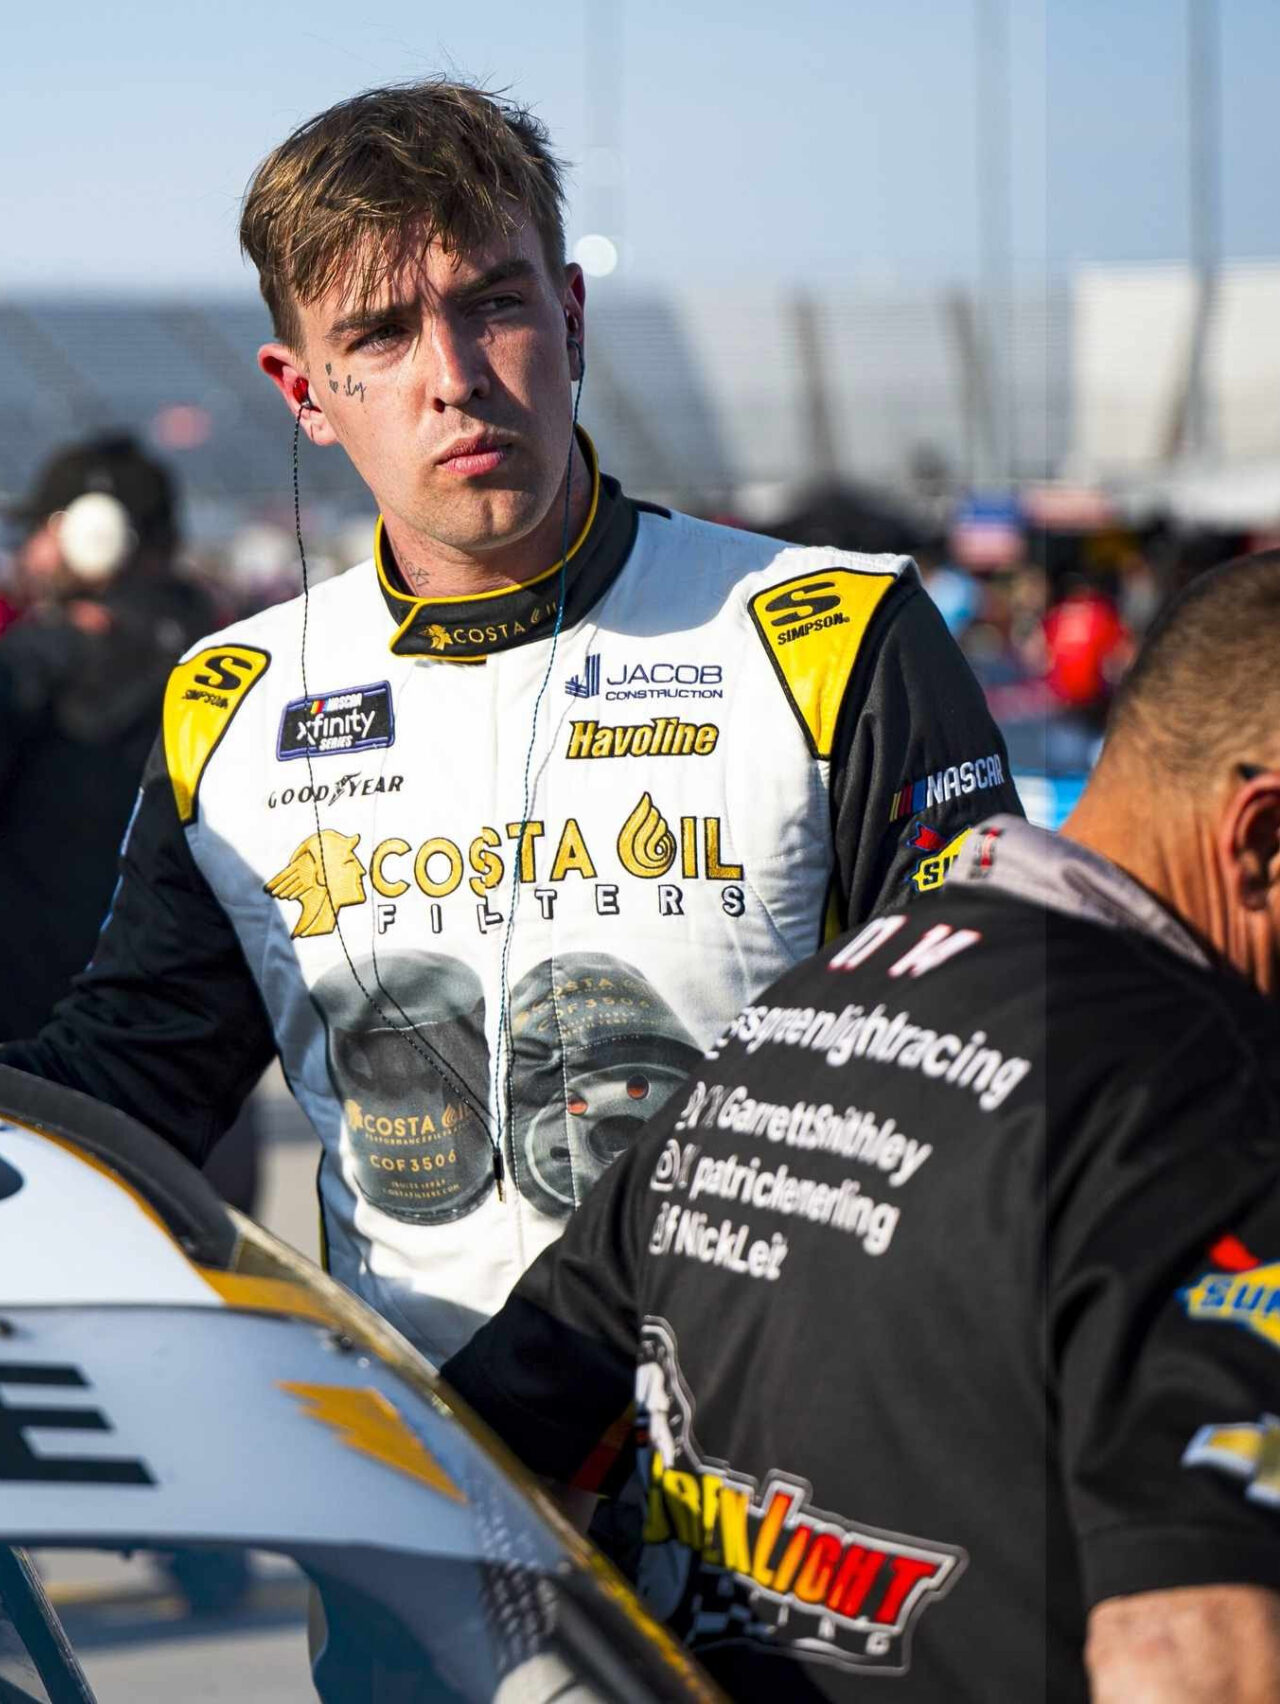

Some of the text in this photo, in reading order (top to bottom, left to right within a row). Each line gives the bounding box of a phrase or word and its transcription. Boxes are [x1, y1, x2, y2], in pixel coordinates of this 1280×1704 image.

[453, 621, 526, 644] COSTA
[777, 612, 844, 646] SIMPSON
[607, 664, 723, 685] JACOB
[181, 689, 230, 710] SIMPSON
[606, 689, 724, 701] CONSTRUCTION
[319, 735, 354, 751] SERIES
[566, 717, 719, 759] Havoline
[926, 754, 1004, 808] NASCAR
[368, 818, 598, 900] COSTA
[377, 884, 746, 934] FILTERS
[363, 1114, 436, 1137] COSTA
